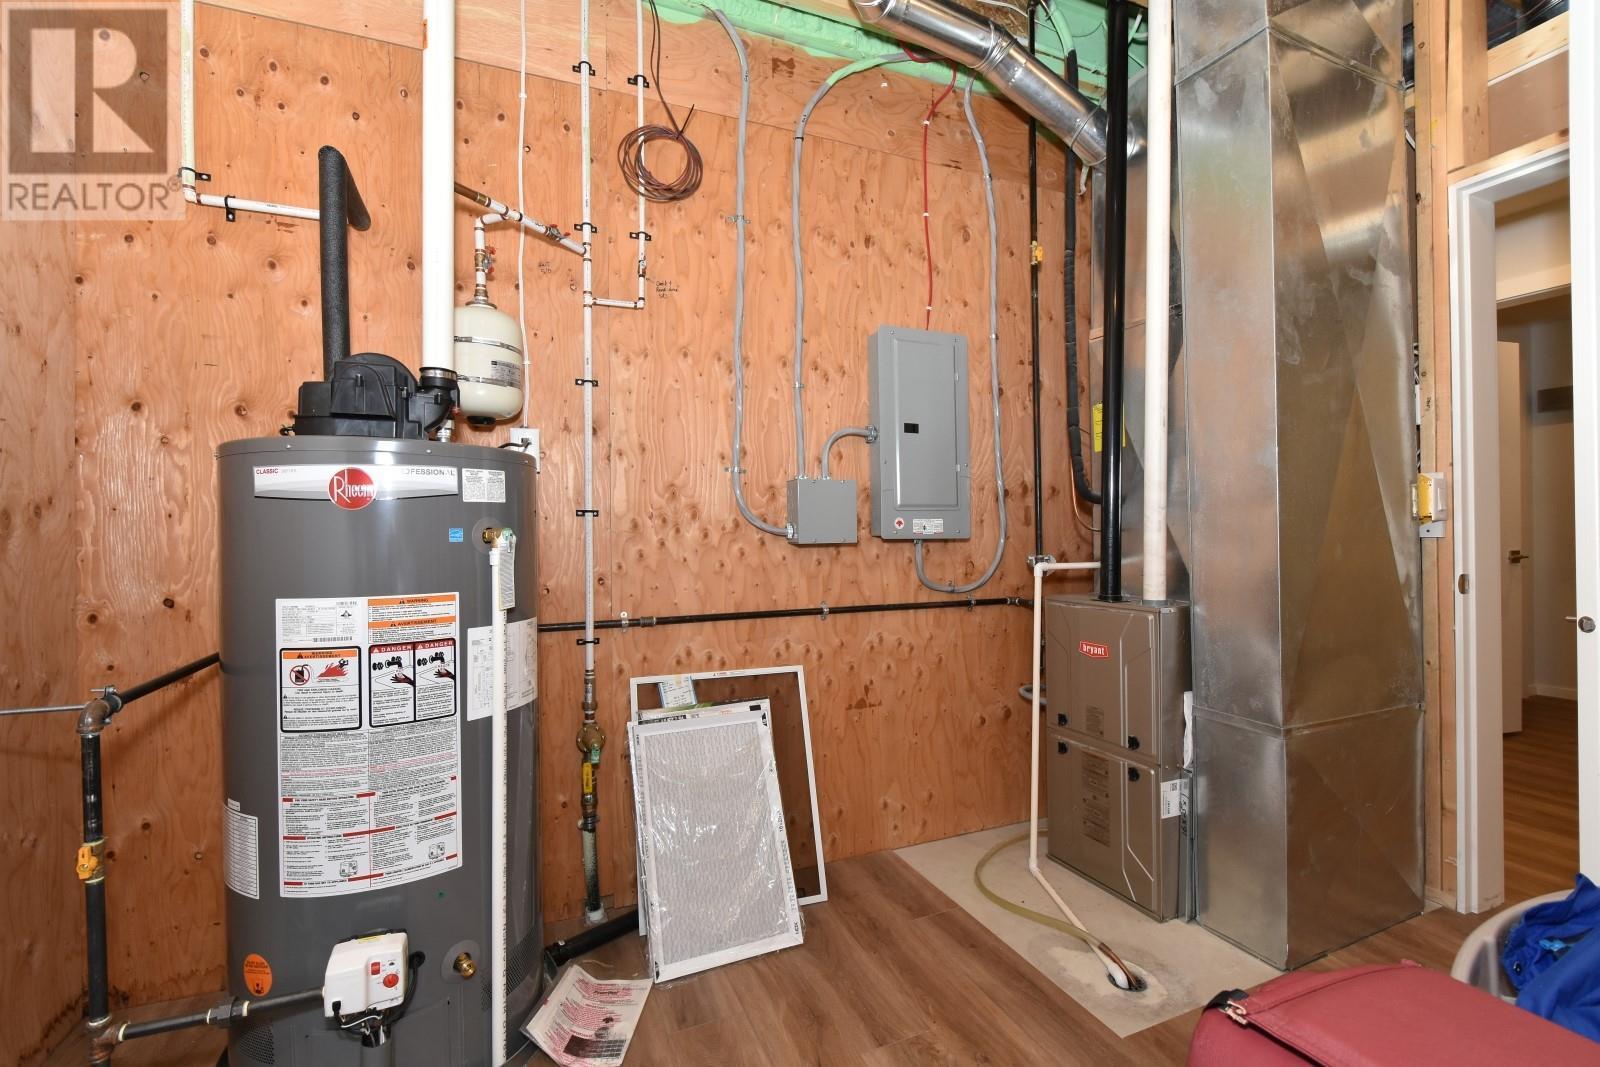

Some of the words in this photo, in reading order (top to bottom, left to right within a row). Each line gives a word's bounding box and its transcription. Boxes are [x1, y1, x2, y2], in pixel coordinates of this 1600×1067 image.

[333, 468, 375, 503] Rheem
[425, 640, 453, 648] DANGER
[1082, 643, 1105, 656] bryant
